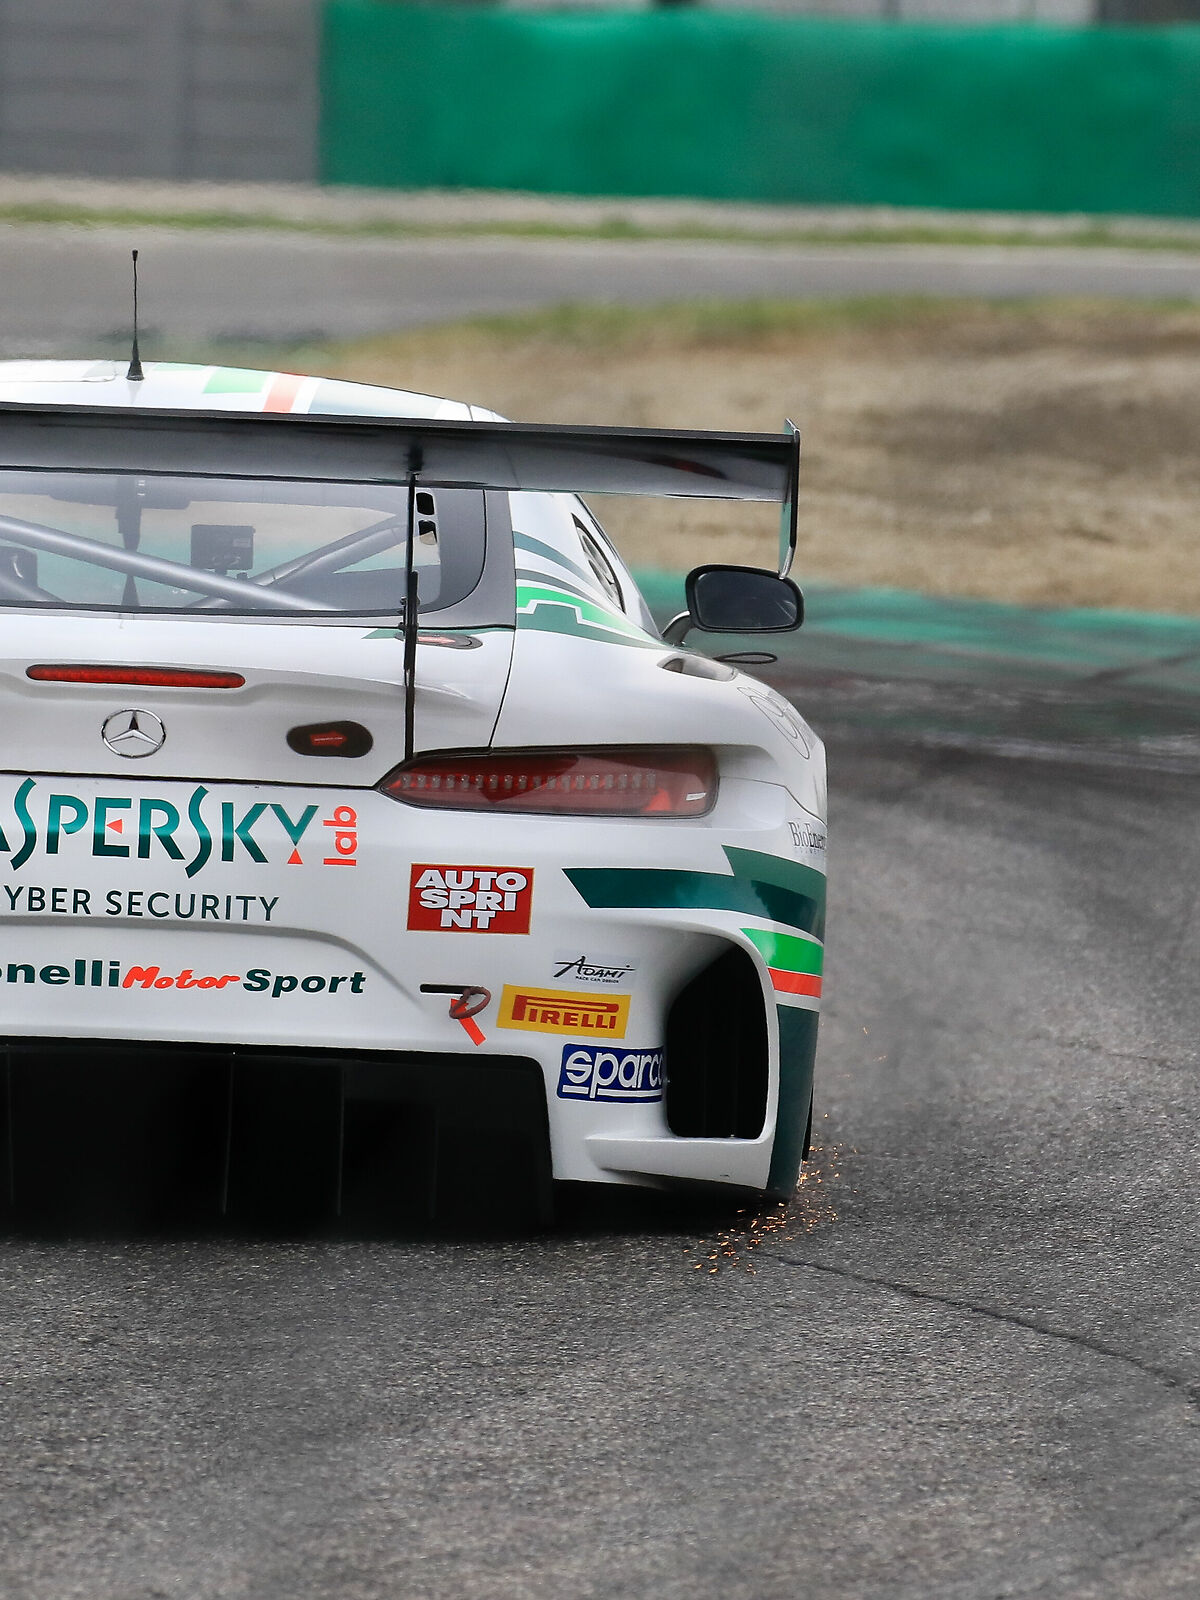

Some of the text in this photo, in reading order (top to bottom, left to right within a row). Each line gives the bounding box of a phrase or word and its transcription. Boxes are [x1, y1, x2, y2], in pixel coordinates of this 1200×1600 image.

[323, 805, 358, 866] lab
[414, 869, 527, 892] AUTO
[105, 890, 279, 921] SECURITY
[419, 888, 517, 911] SPRI
[440, 909, 496, 929] NT
[511, 994, 620, 1029] PIRELLI
